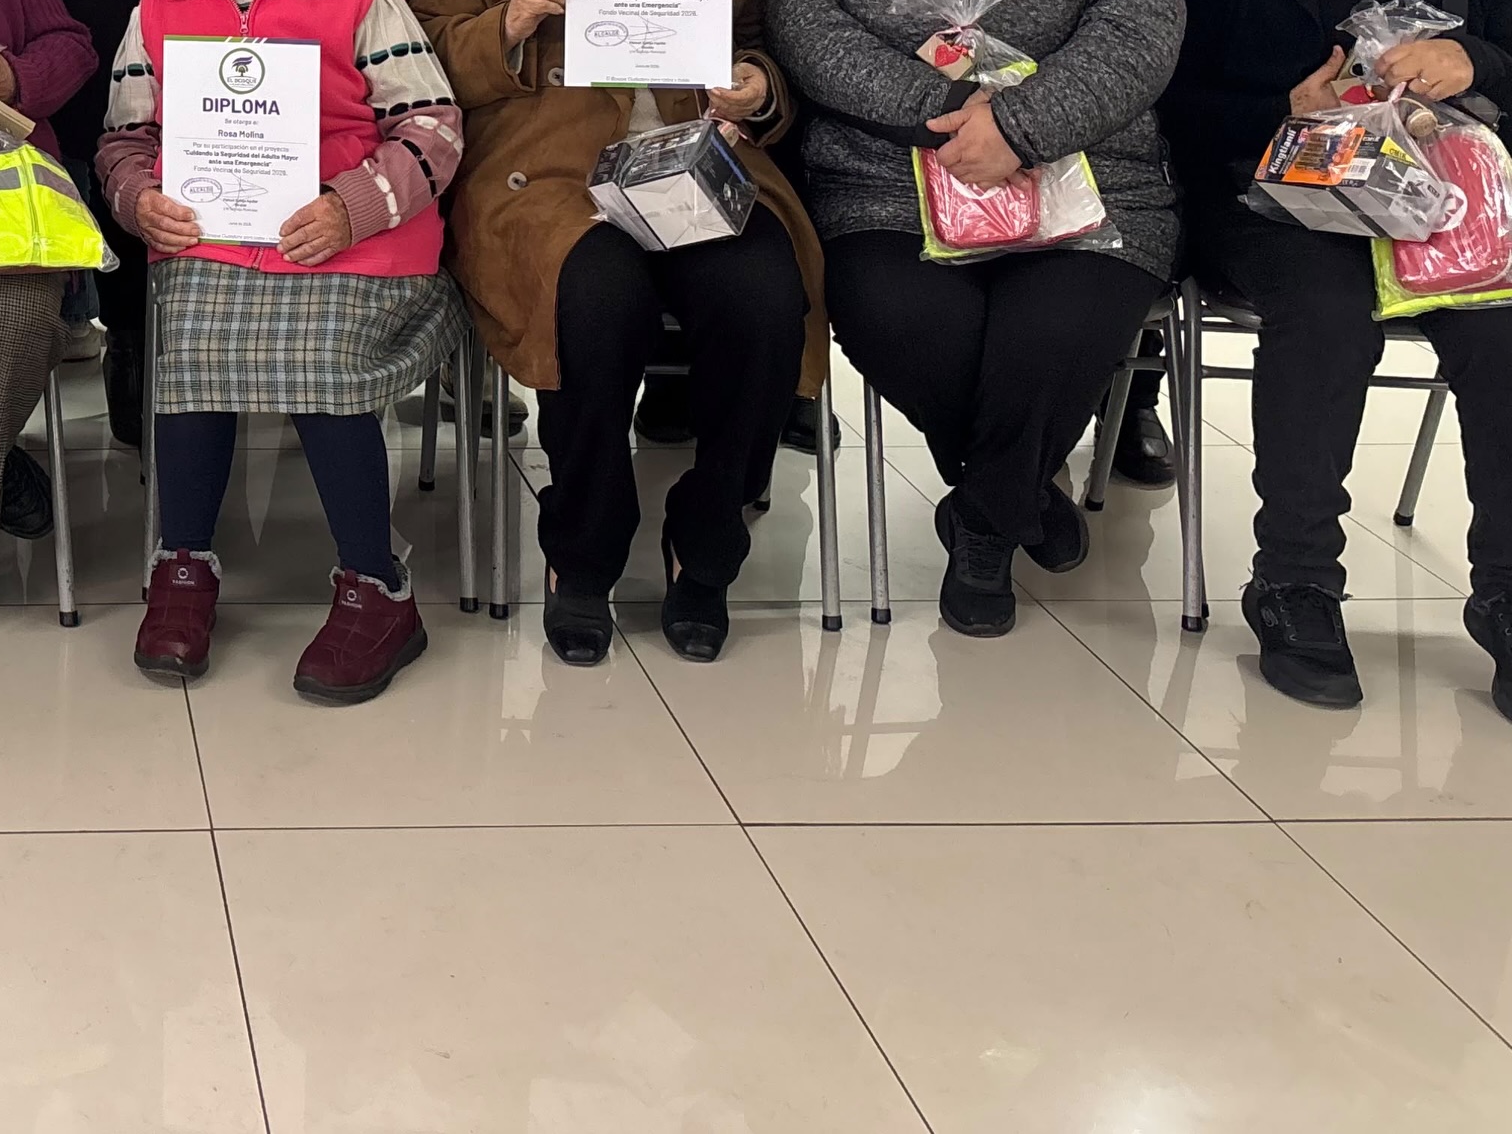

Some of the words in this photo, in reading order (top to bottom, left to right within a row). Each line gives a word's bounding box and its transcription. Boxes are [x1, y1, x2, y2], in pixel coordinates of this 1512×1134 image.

[203, 97, 280, 115] DIPLOMA
[218, 129, 237, 137] Rosa
[239, 131, 264, 139] Molina
[1268, 128, 1297, 174] Kingtianli
